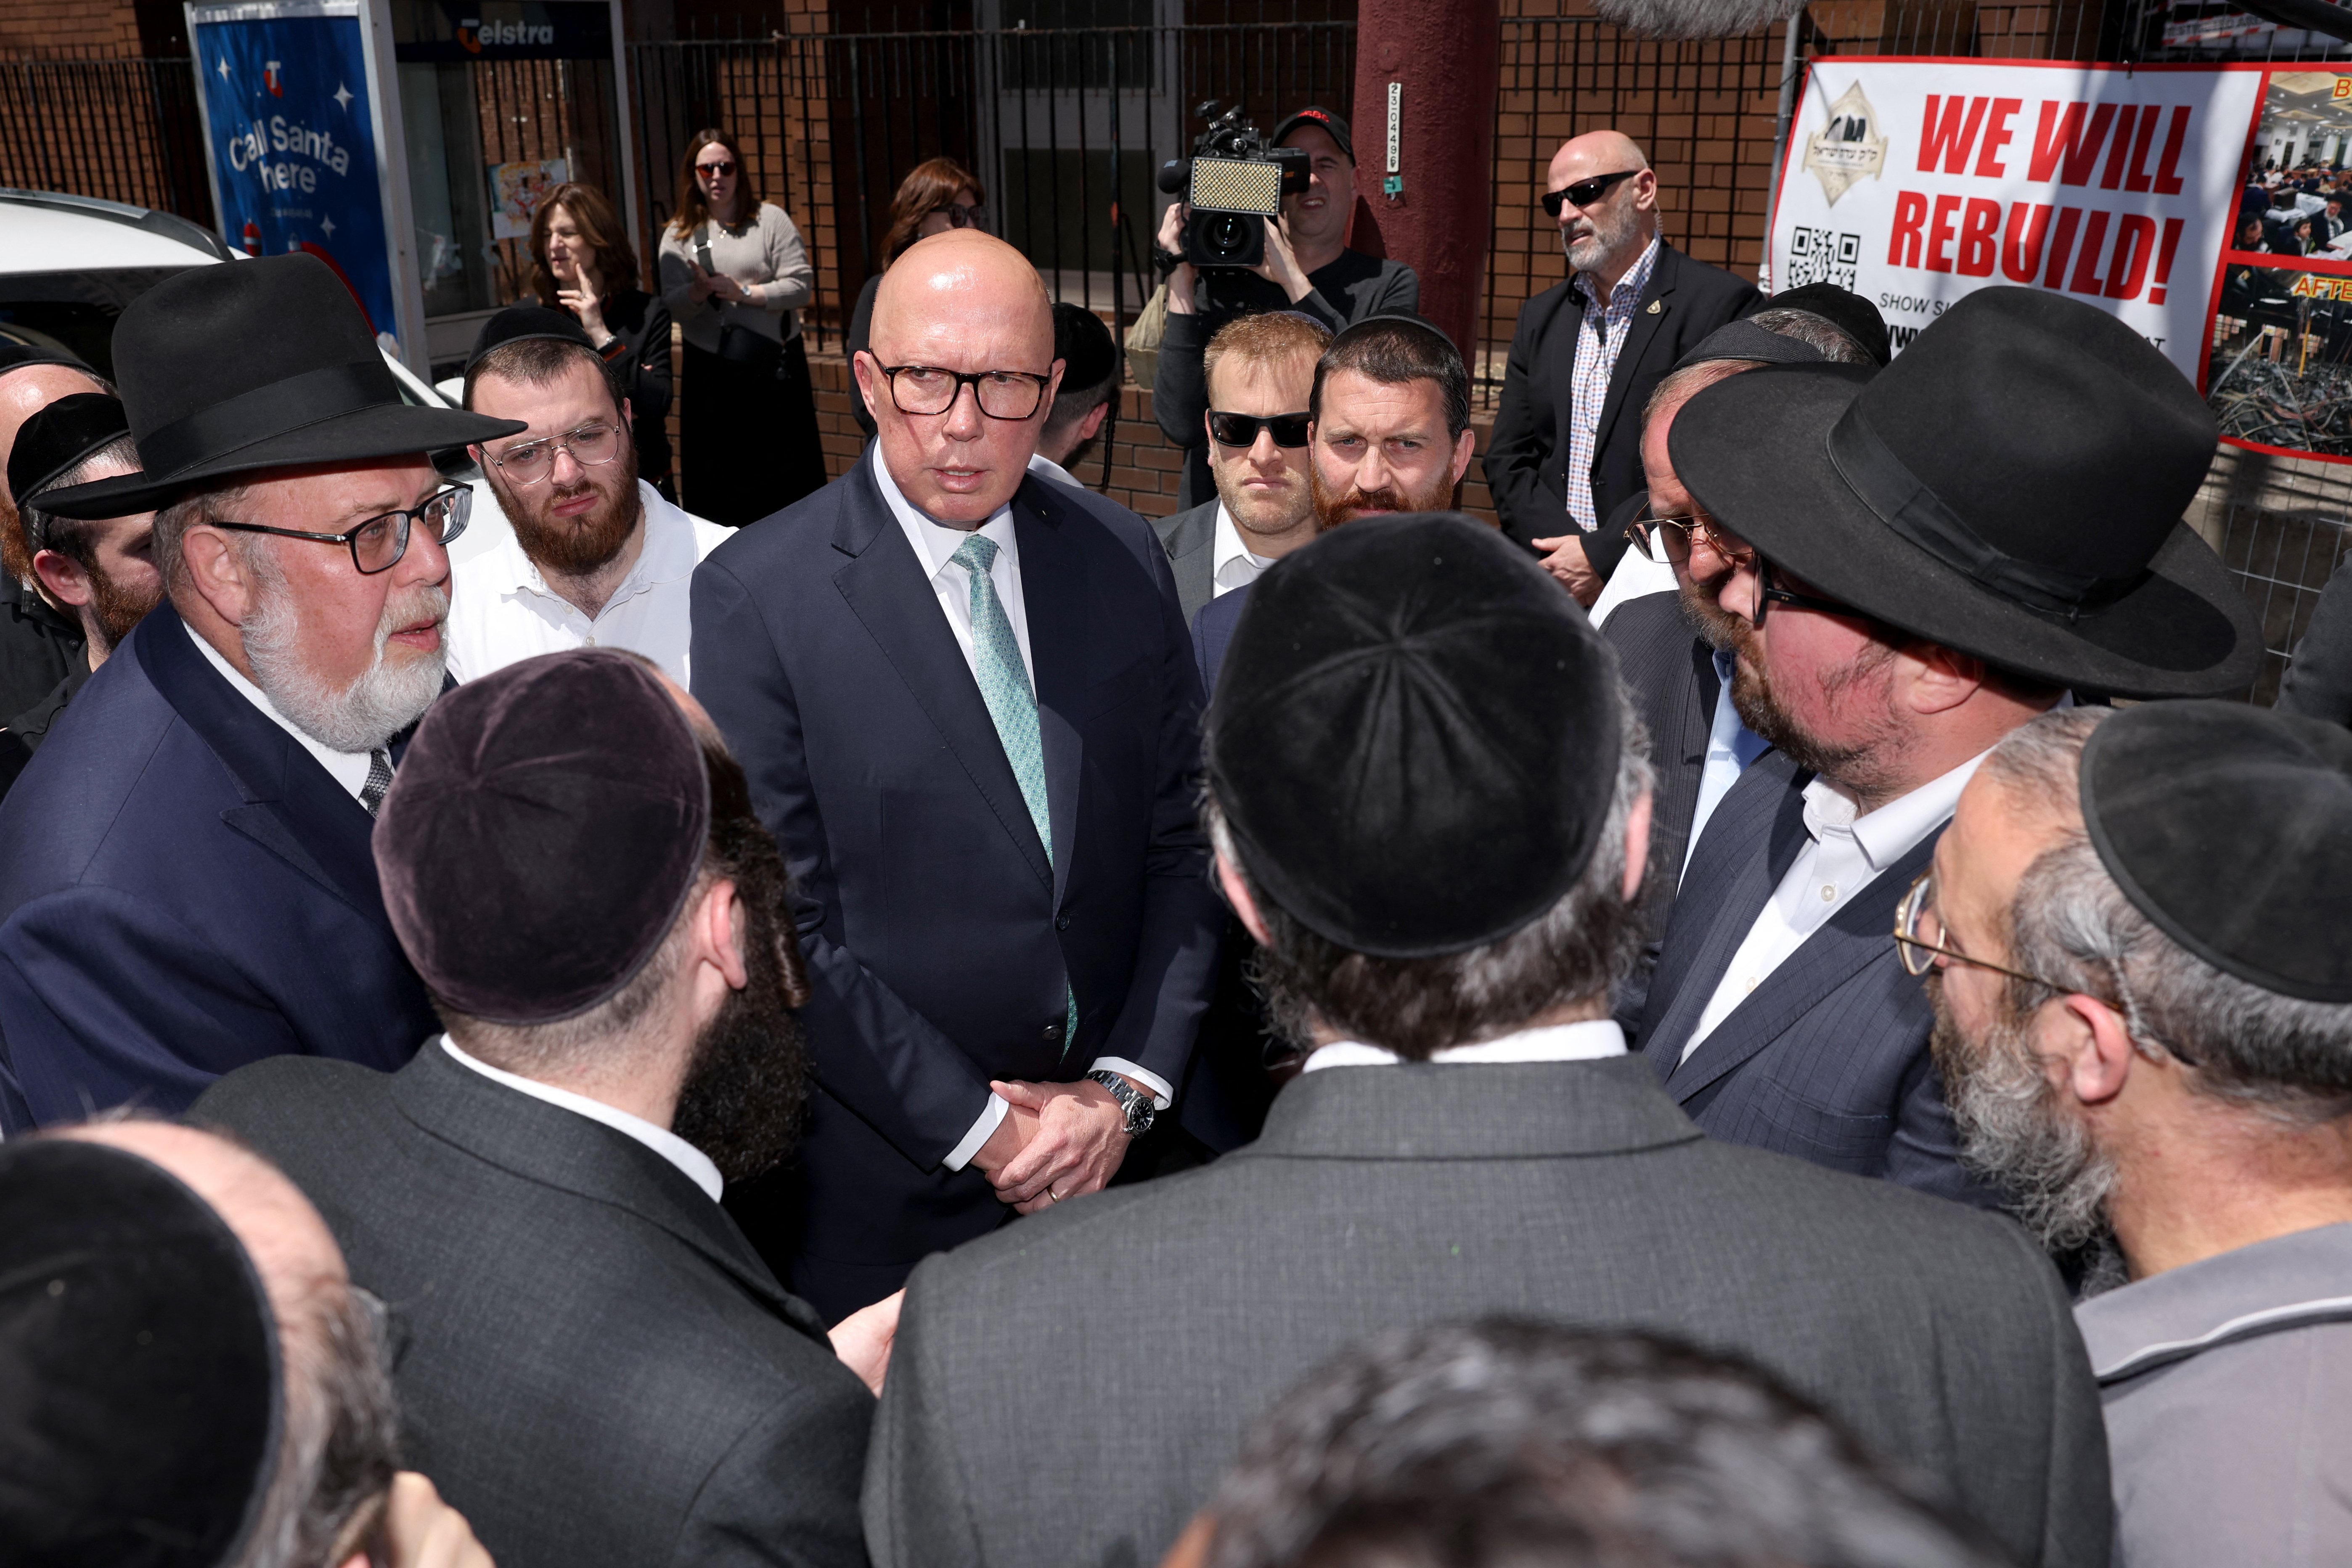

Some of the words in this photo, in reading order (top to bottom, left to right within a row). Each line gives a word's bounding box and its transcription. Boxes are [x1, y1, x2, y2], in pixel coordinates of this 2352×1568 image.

[458, 19, 554, 49] Telstra
[229, 119, 270, 172] Call
[270, 114, 350, 177] Santa
[1390, 84, 1398, 167] 23-04496
[1918, 95, 2022, 177] WE
[2028, 101, 2192, 195] WILL
[258, 160, 316, 194] here
[1887, 191, 2184, 305] REBUILD!
[1879, 292, 1930, 314] SHOW
[1933, 300, 1950, 316] S
